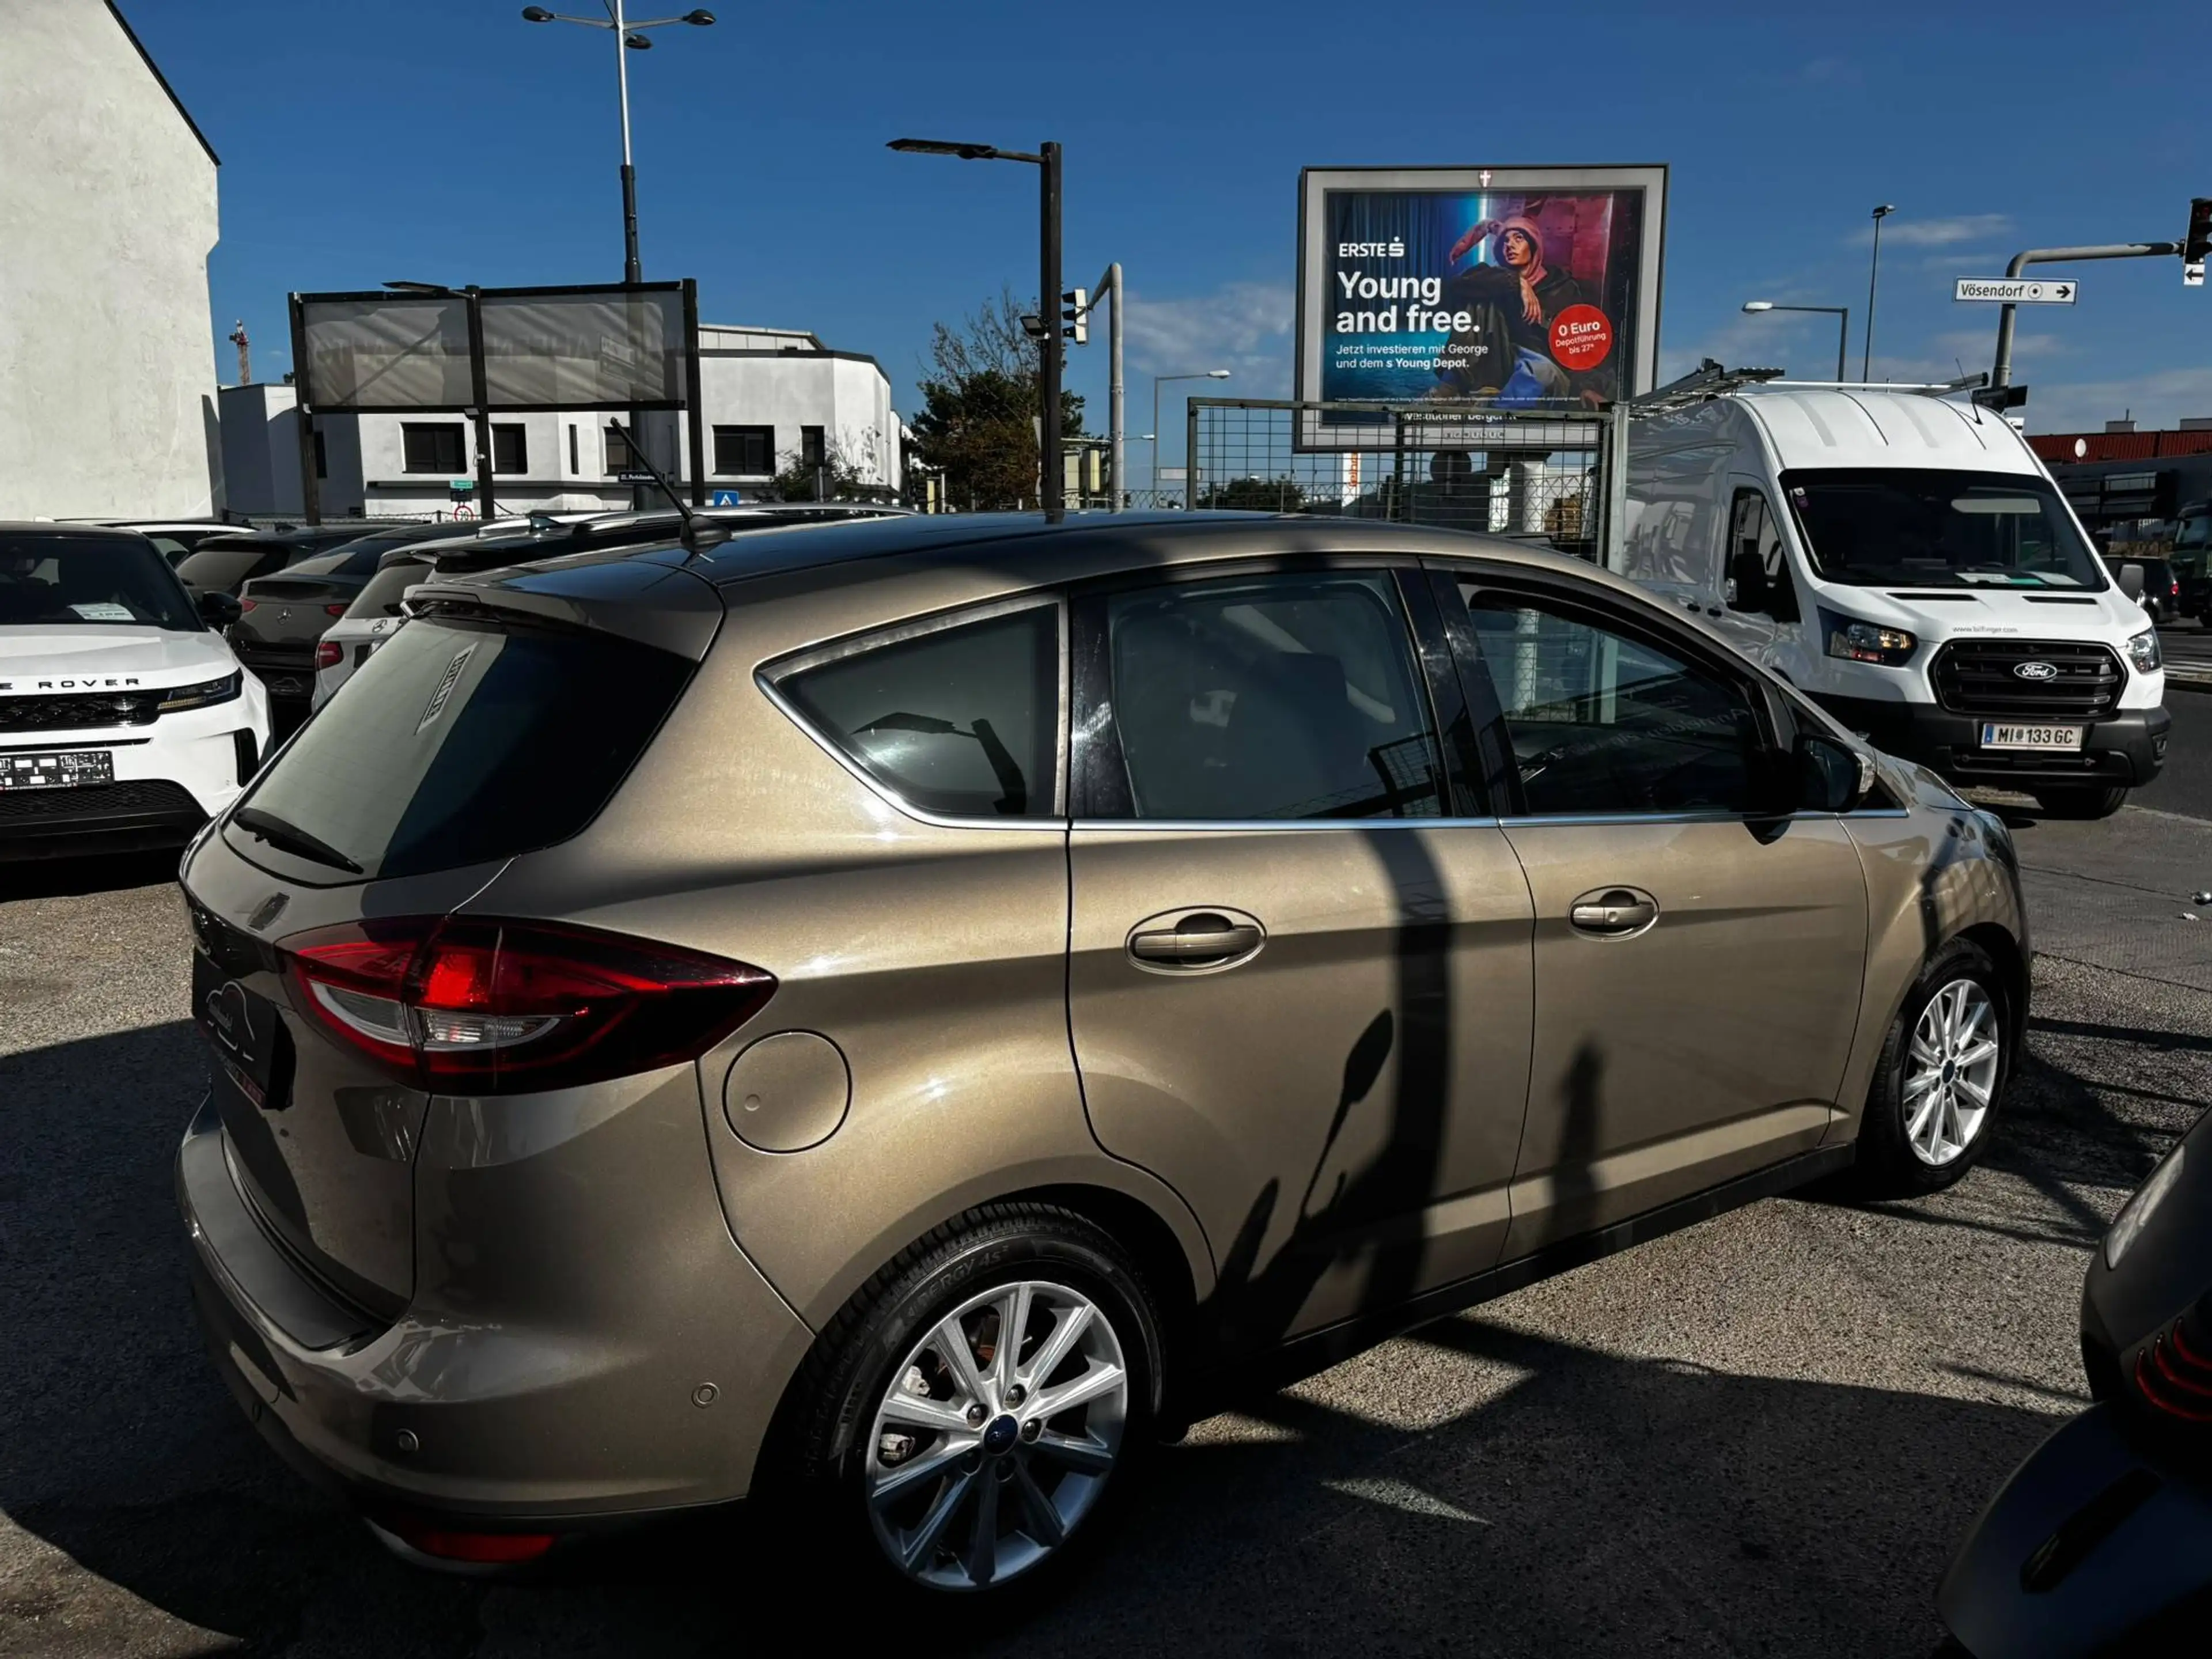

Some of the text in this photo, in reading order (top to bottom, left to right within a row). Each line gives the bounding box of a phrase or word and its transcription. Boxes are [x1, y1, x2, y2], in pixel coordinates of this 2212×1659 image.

[1339, 243, 1387, 257] ERSTE
[1337, 271, 1441, 306] Young
[1961, 283, 2025, 297] Vösendorf
[1336, 304, 1480, 333] and free.
[1558, 321, 1601, 337] 0 Euro
[1555, 333, 1607, 348] Depotführung
[1336, 343, 1488, 357] Jetzt investieren mit George
[1569, 345, 1580, 355] bis
[1336, 357, 1470, 370] und dem s Young Depot.
[2022, 665, 2049, 676] Ford
[38, 678, 139, 689] ROVER
[1998, 728, 2074, 744] MI 133 GC
